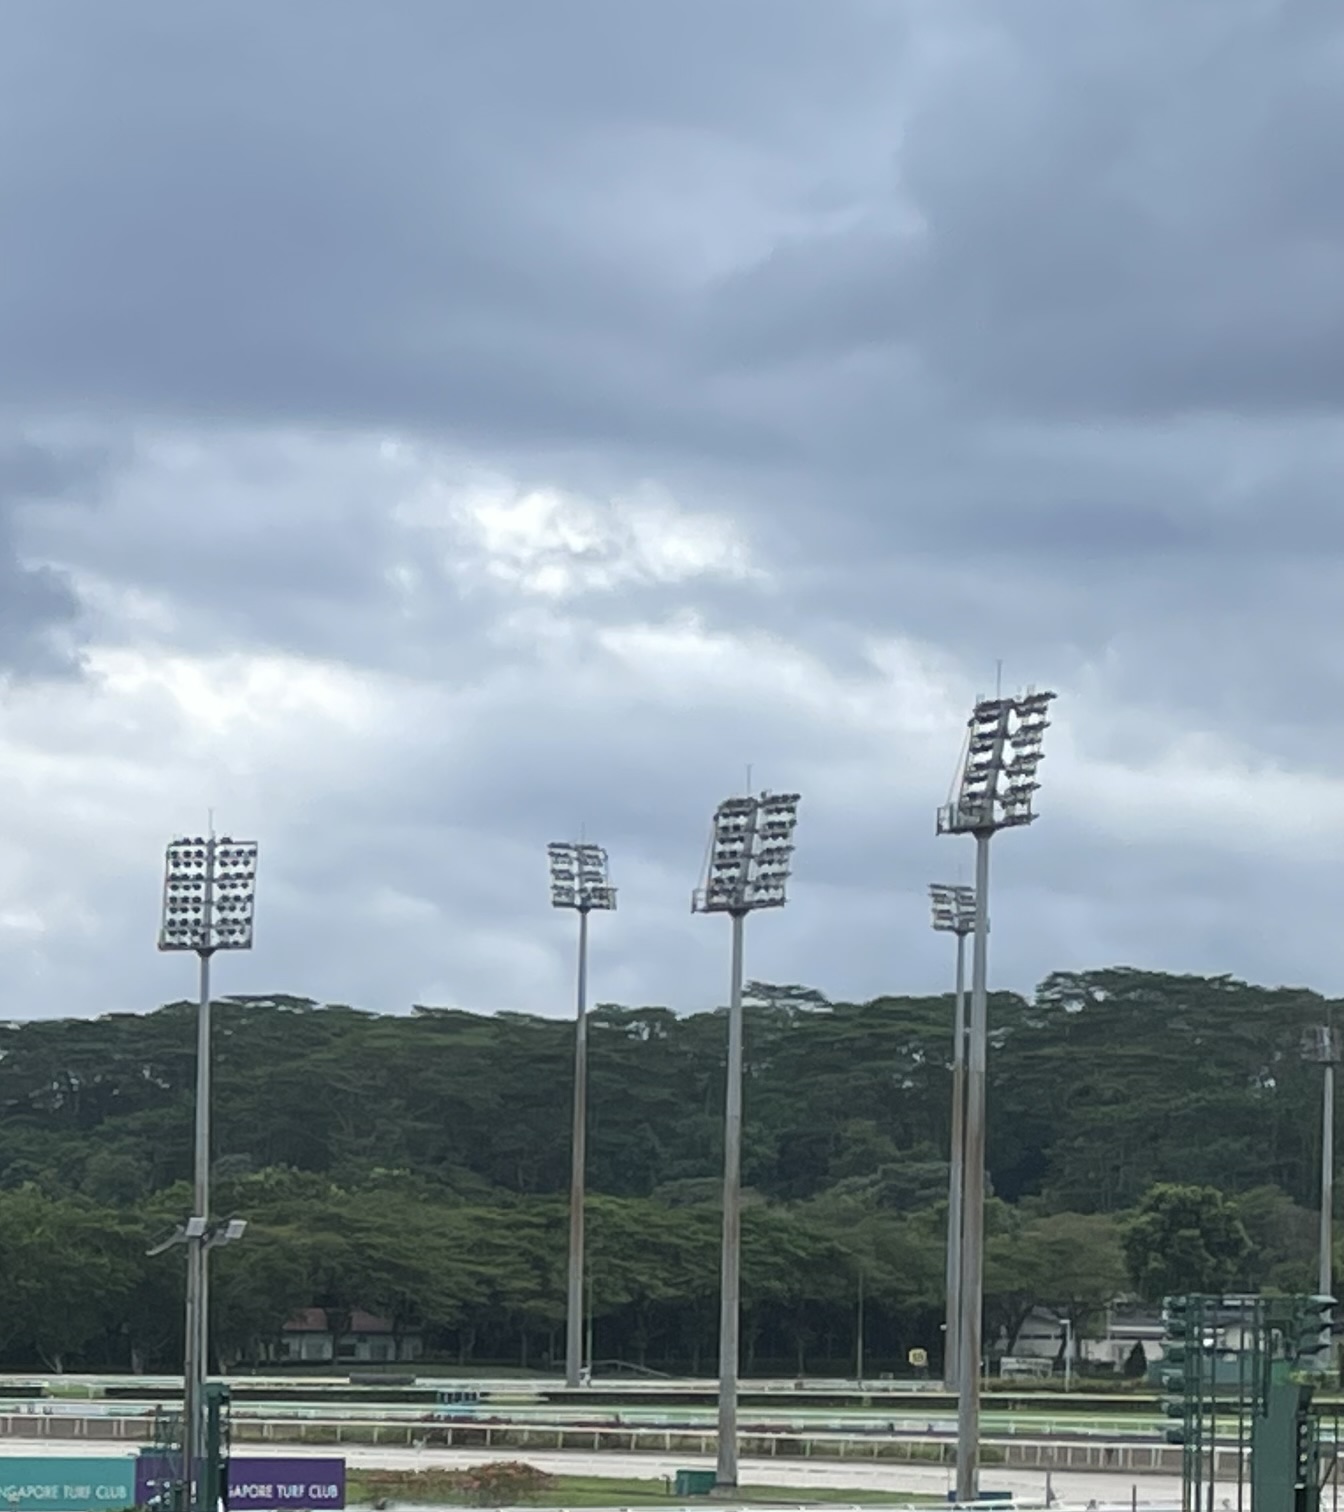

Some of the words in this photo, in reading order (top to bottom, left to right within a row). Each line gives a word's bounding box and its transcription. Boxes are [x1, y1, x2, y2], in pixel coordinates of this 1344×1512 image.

[63, 1485, 91, 1499] TURF
[96, 1485, 127, 1499] CLUB
[276, 1484, 305, 1498] TURF
[309, 1484, 338, 1499] CLUB
